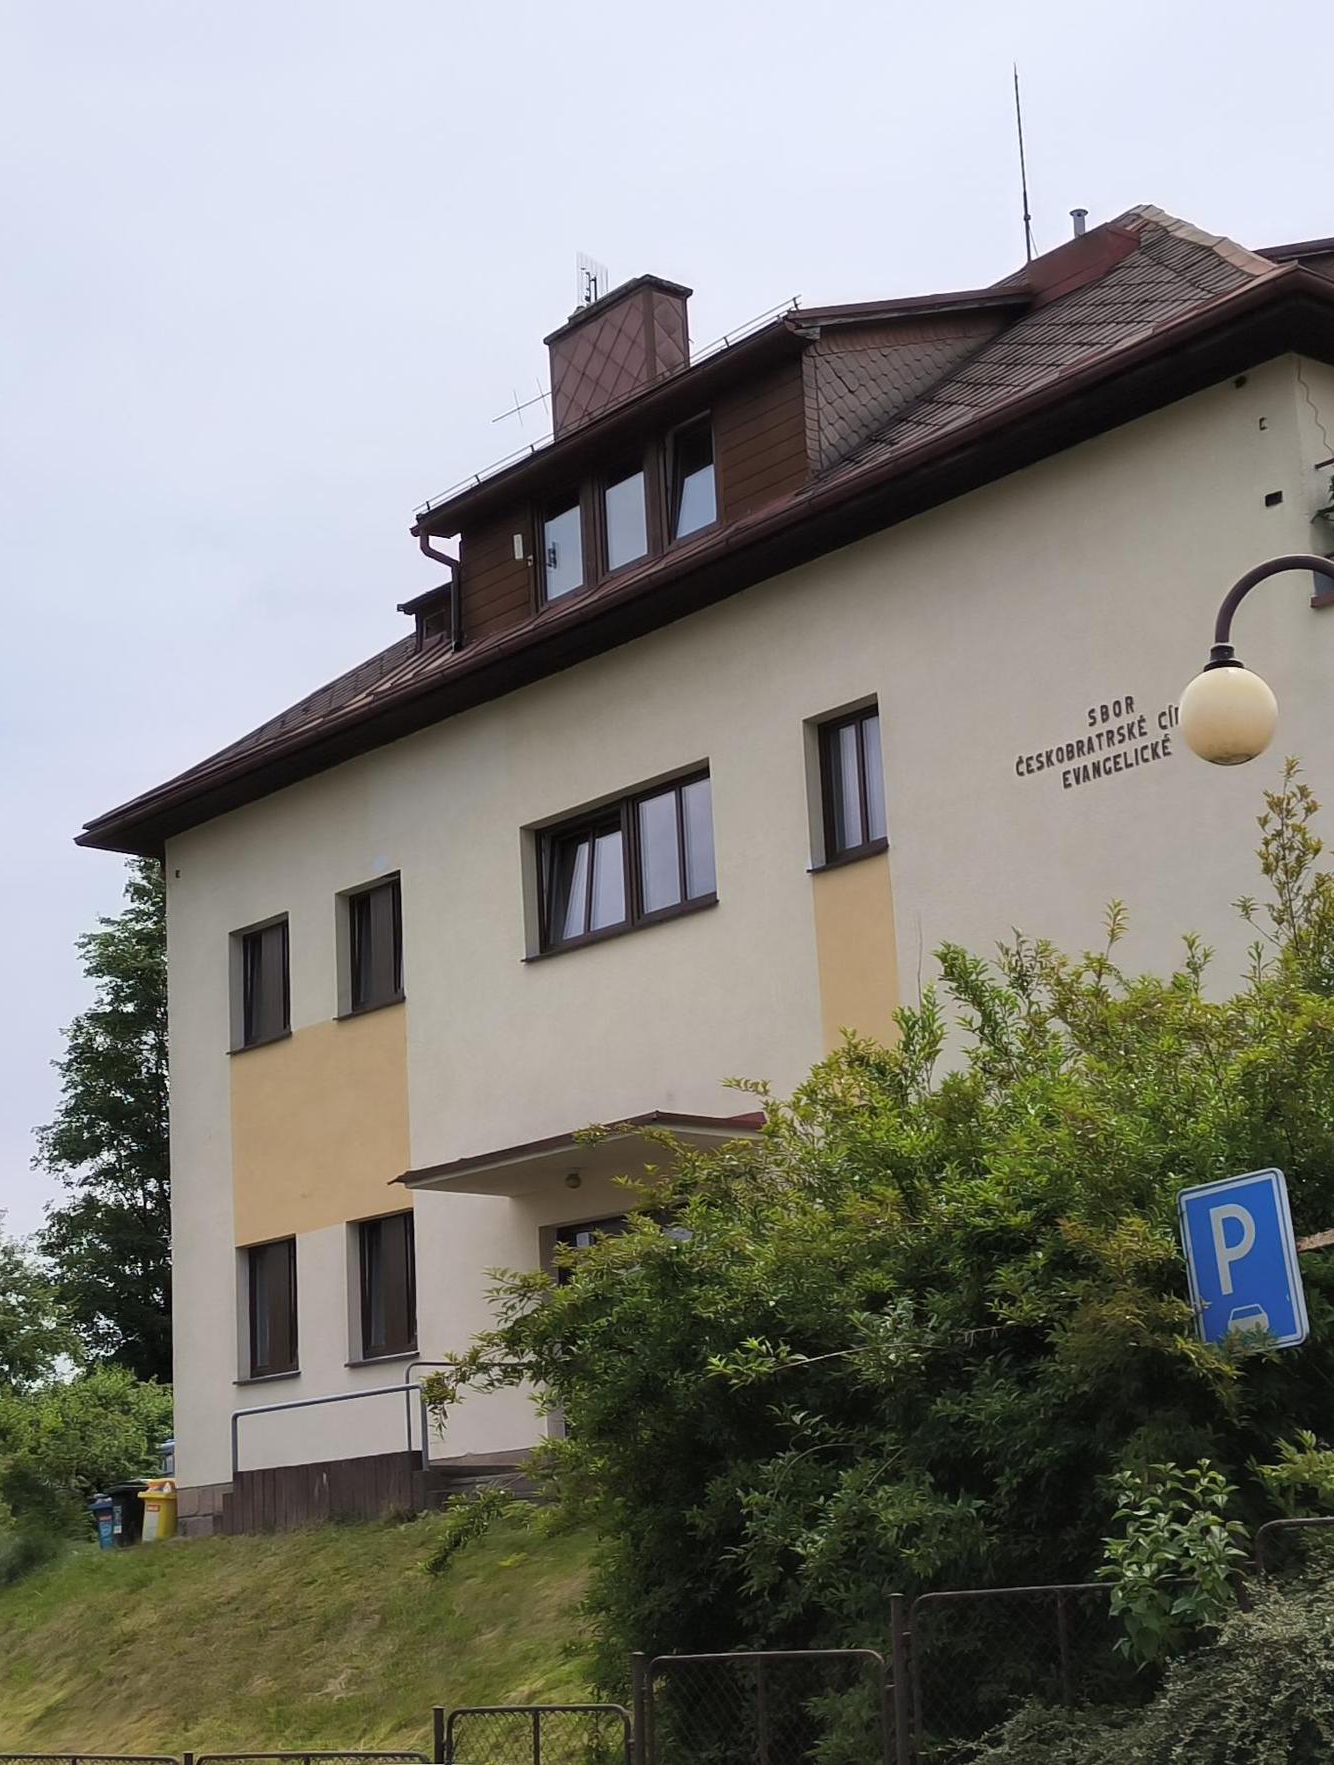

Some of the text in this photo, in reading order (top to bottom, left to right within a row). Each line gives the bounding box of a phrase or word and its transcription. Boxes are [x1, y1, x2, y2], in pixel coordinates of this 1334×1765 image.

[1087, 695, 1135, 727] SBOR
[1015, 714, 1148, 777] ČESKOBRATRSKÉ
[1062, 733, 1173, 789] EVANGELICKÉ
[1209, 1203, 1256, 1296] P
